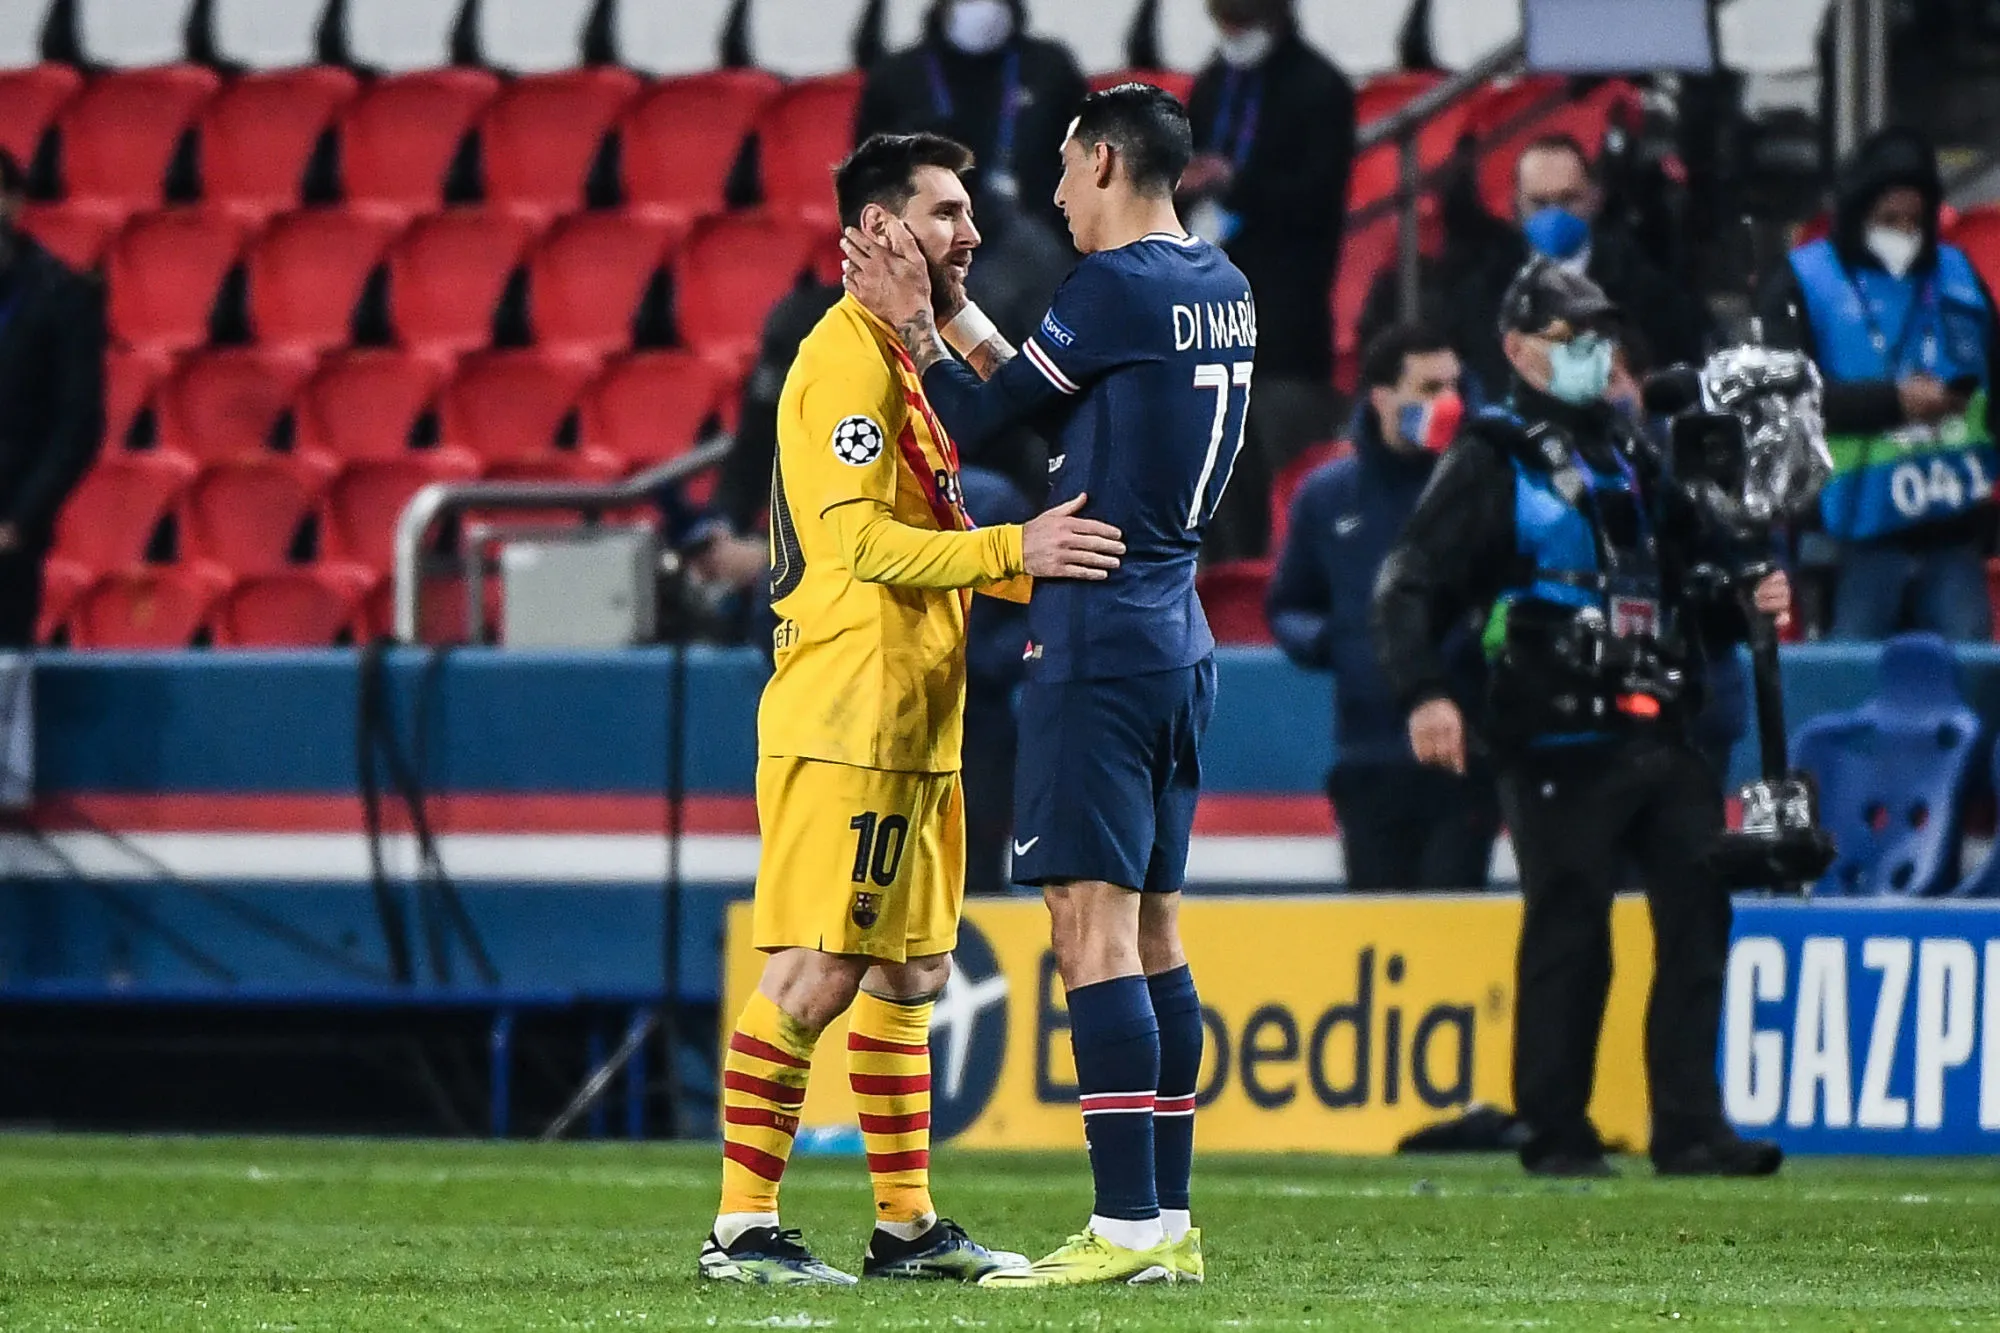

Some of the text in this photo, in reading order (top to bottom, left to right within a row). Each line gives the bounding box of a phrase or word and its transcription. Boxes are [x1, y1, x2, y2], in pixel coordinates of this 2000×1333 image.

[1172, 291, 1257, 352] DI MARÍ
[1186, 361, 1254, 530] 77
[1892, 454, 1991, 517] 041
[849, 811, 909, 887] 10
[1036, 946, 1477, 1108] Epedia
